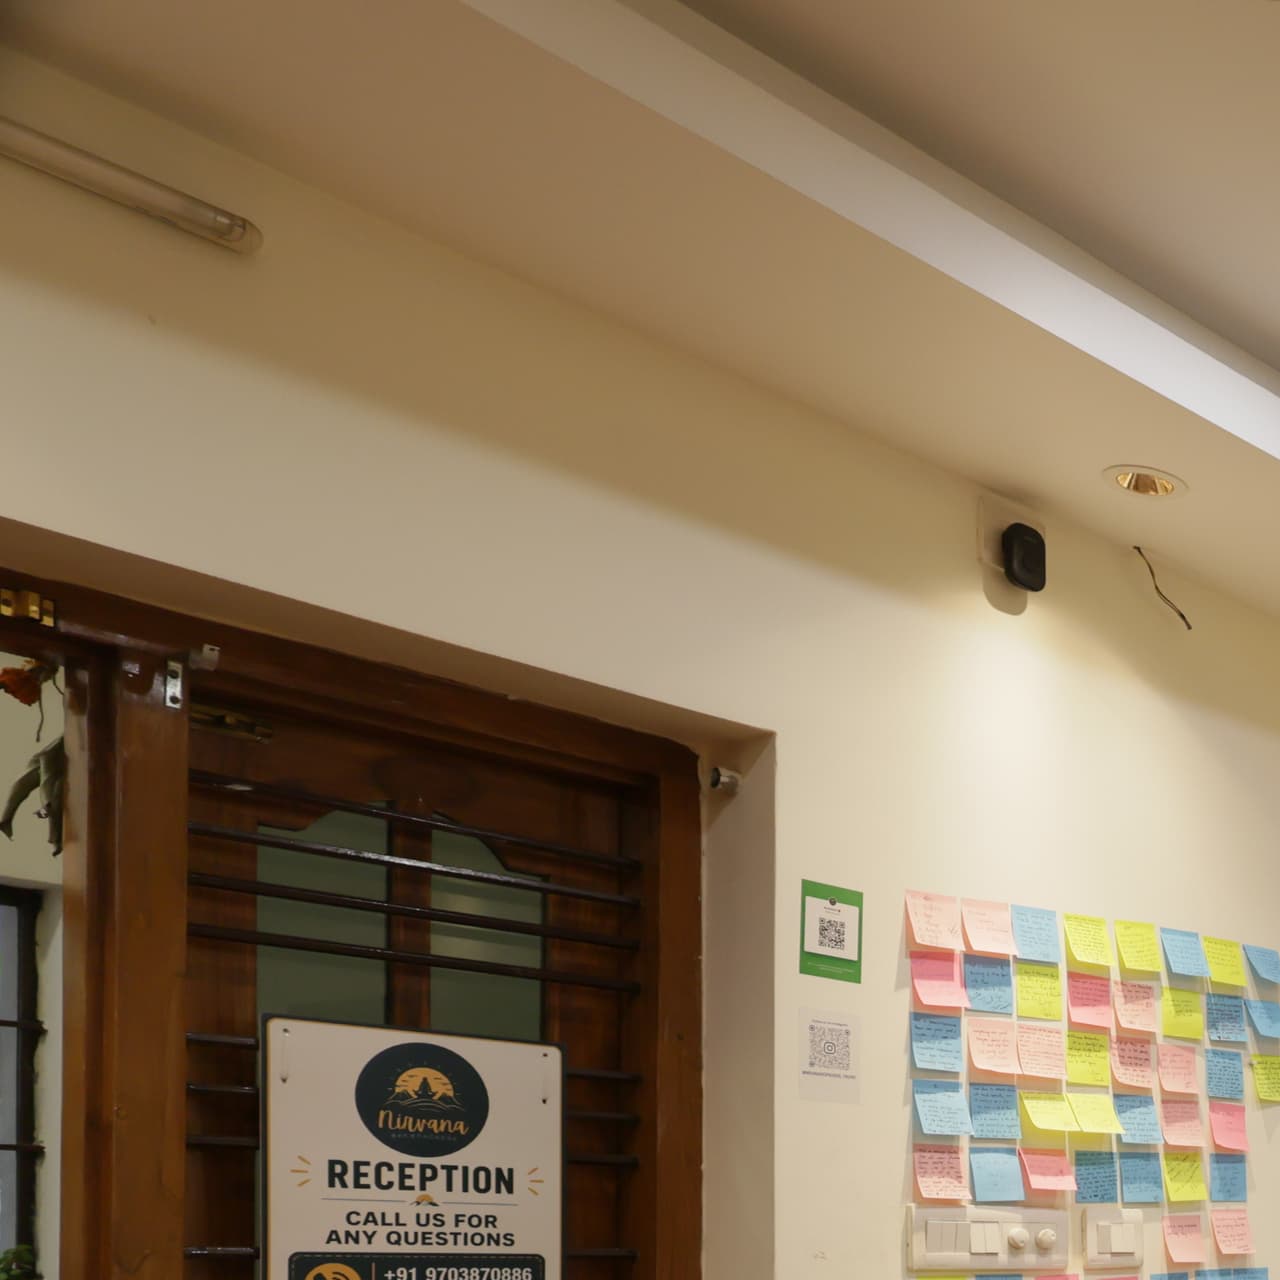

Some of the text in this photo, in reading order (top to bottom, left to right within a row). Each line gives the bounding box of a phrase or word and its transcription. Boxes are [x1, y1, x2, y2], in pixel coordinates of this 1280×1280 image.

[377, 1109, 471, 1136] Nirvana
[327, 1159, 515, 1195] RECEPTION
[345, 1210, 498, 1229] CALL US FOR
[325, 1230, 516, 1247] ANY QUESTIONS
